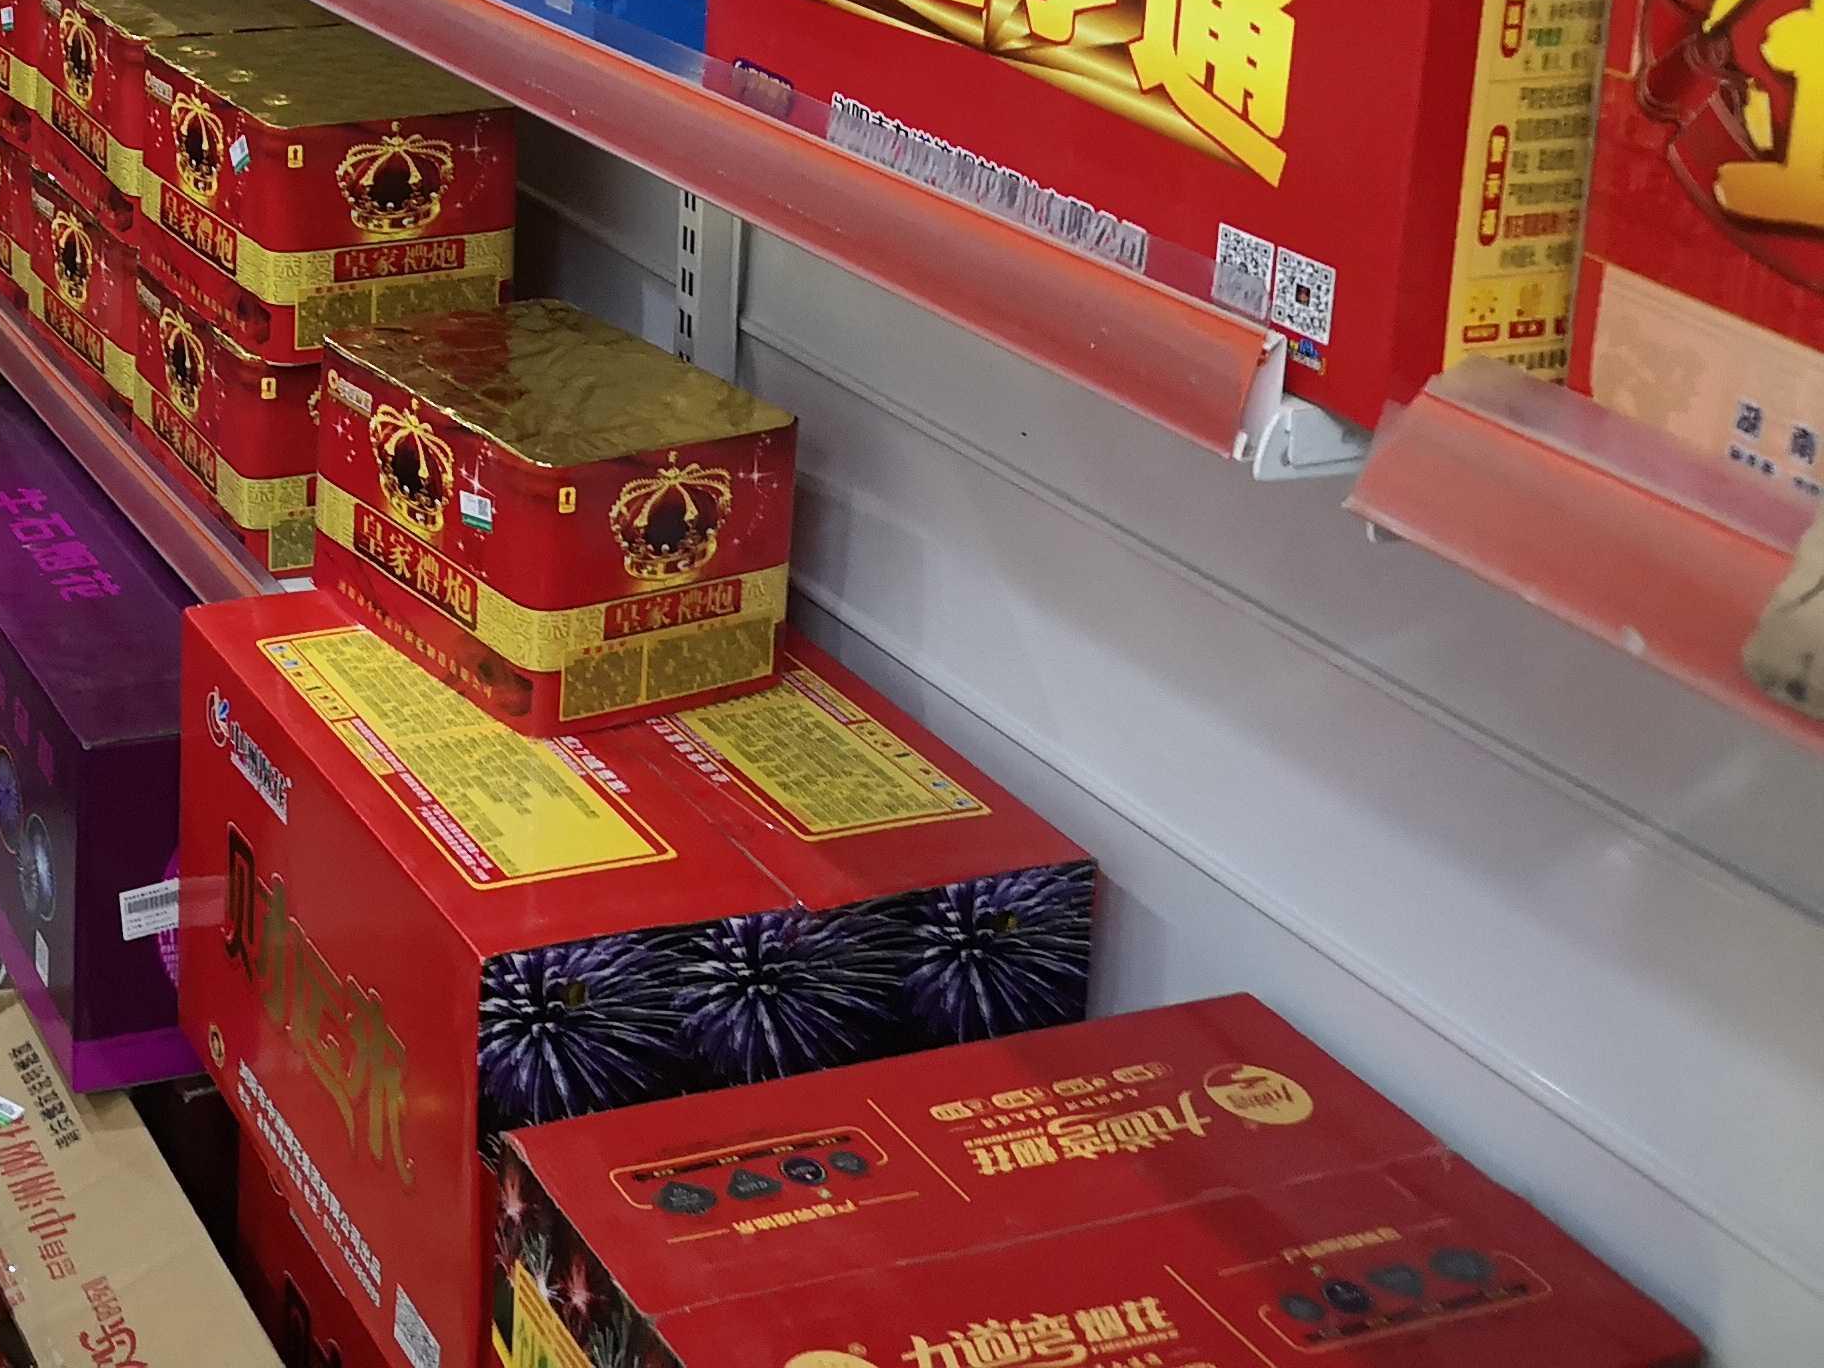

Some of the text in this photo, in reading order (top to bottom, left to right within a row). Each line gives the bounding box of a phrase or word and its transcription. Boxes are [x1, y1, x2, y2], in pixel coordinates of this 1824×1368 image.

[163, 192, 236, 272] 皇家禮炮
[344, 243, 459, 278] 皇家禮炮
[153, 394, 216, 491] 皇家禮炮
[358, 513, 475, 624] 皇家禮炮
[614, 583, 738, 634] 皇家禮炮
